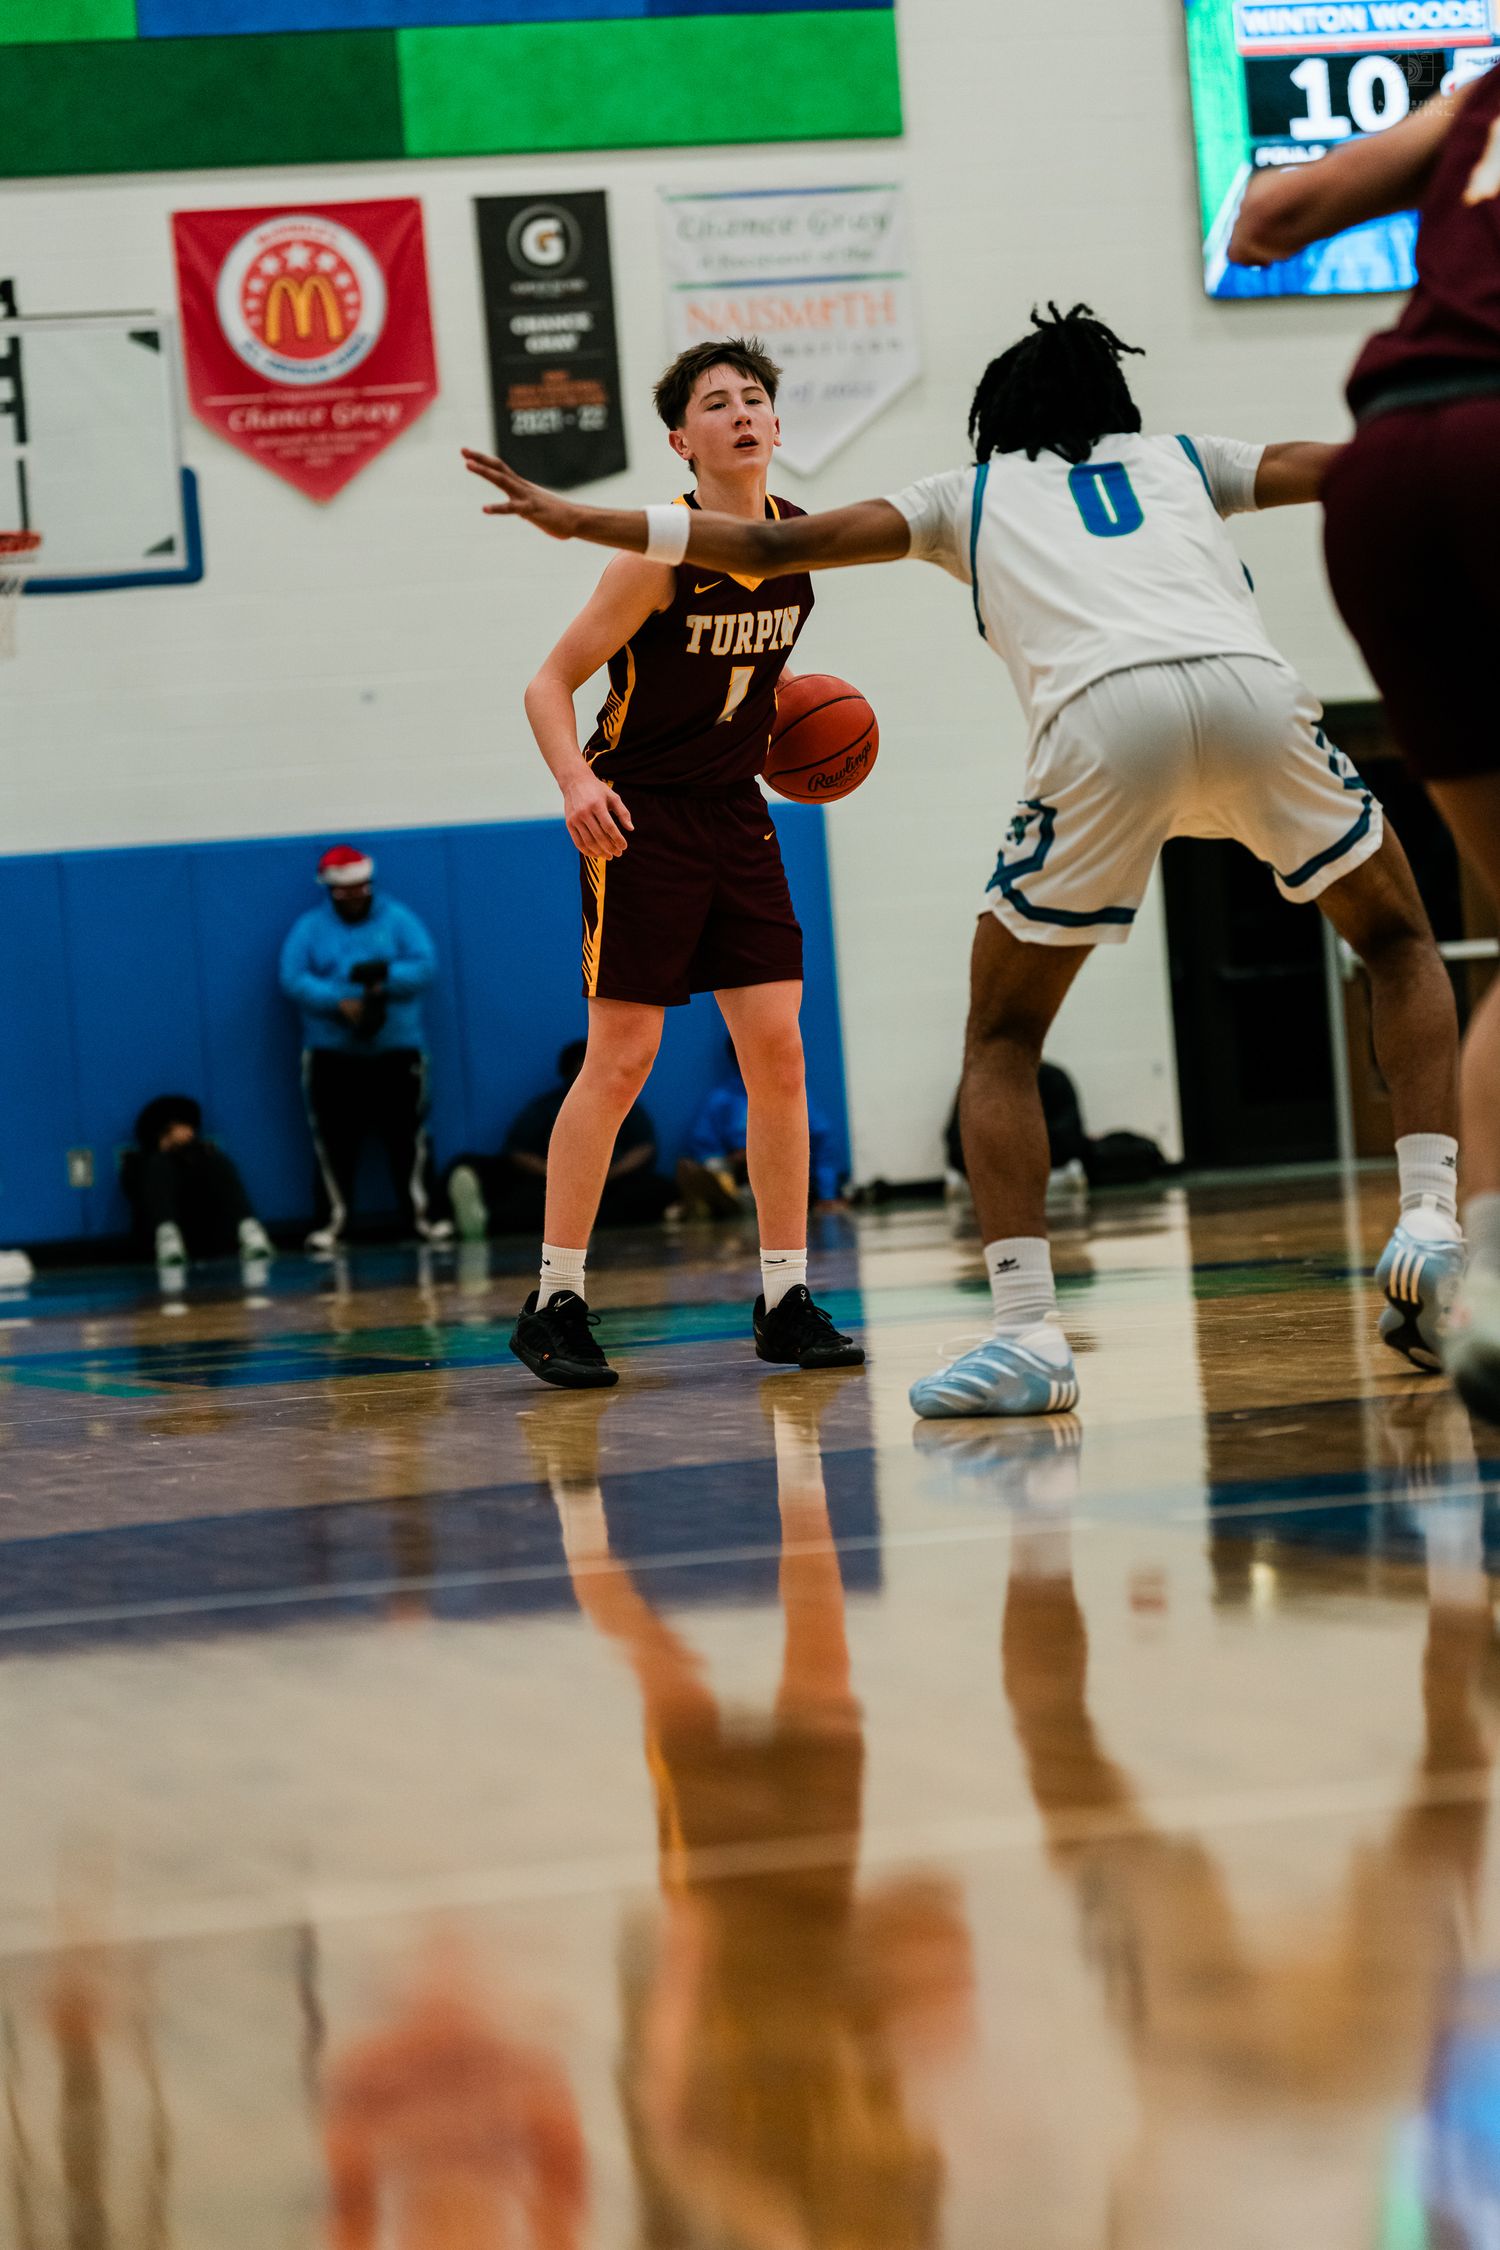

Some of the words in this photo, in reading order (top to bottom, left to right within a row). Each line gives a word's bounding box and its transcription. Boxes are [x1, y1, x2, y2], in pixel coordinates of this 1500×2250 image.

[1241, 5, 1367, 35] WINTON
[1369, 1, 1484, 31] WOODS
[1290, 55, 1410, 141] 10
[686, 289, 896, 335] NAISMITH
[228, 406, 327, 432] Chance
[331, 401, 402, 429] Gray
[1068, 461, 1144, 538] 0
[686, 605, 800, 656] TURPIN
[714, 666, 755, 726] 1
[808, 740, 872, 792] Rawlings
